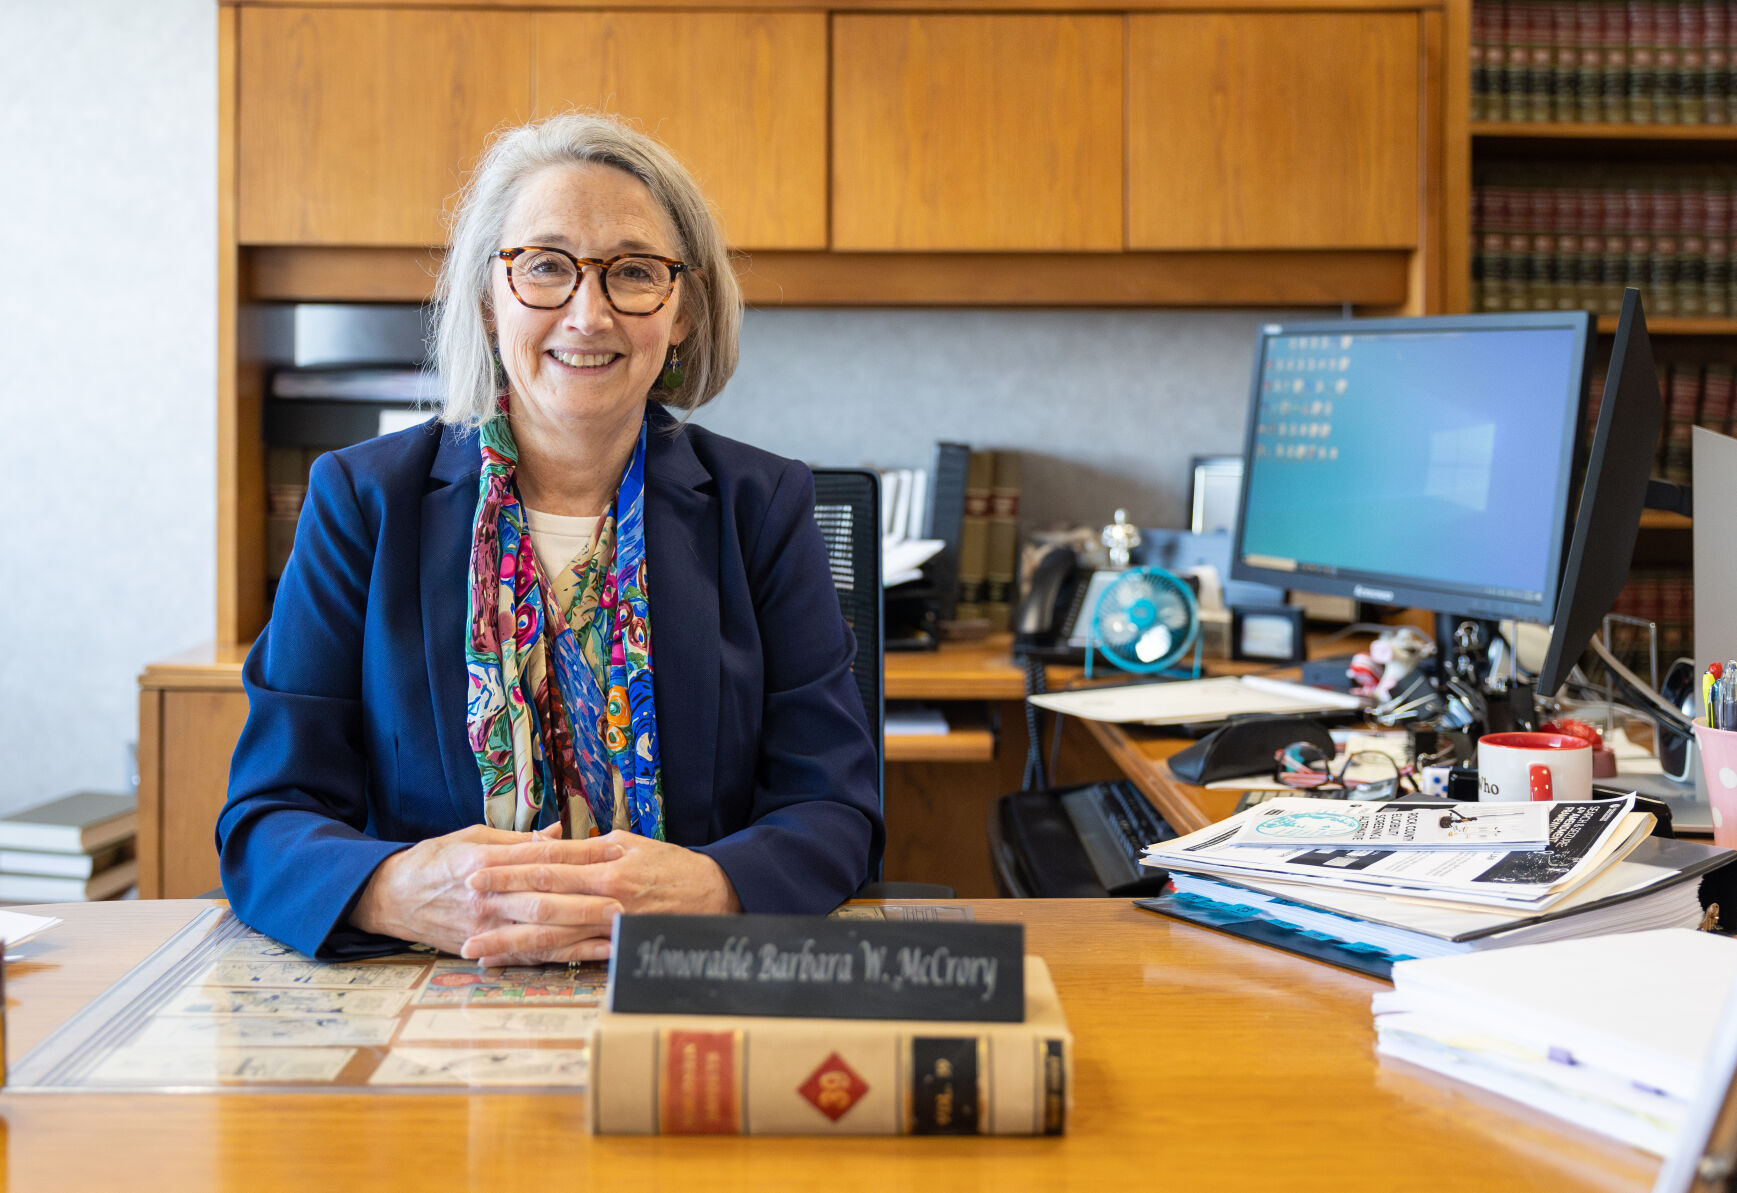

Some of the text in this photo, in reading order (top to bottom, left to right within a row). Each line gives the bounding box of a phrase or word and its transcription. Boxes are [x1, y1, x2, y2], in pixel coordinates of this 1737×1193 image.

[633, 934, 999, 1001] Honorable Barbara W. McCrory
